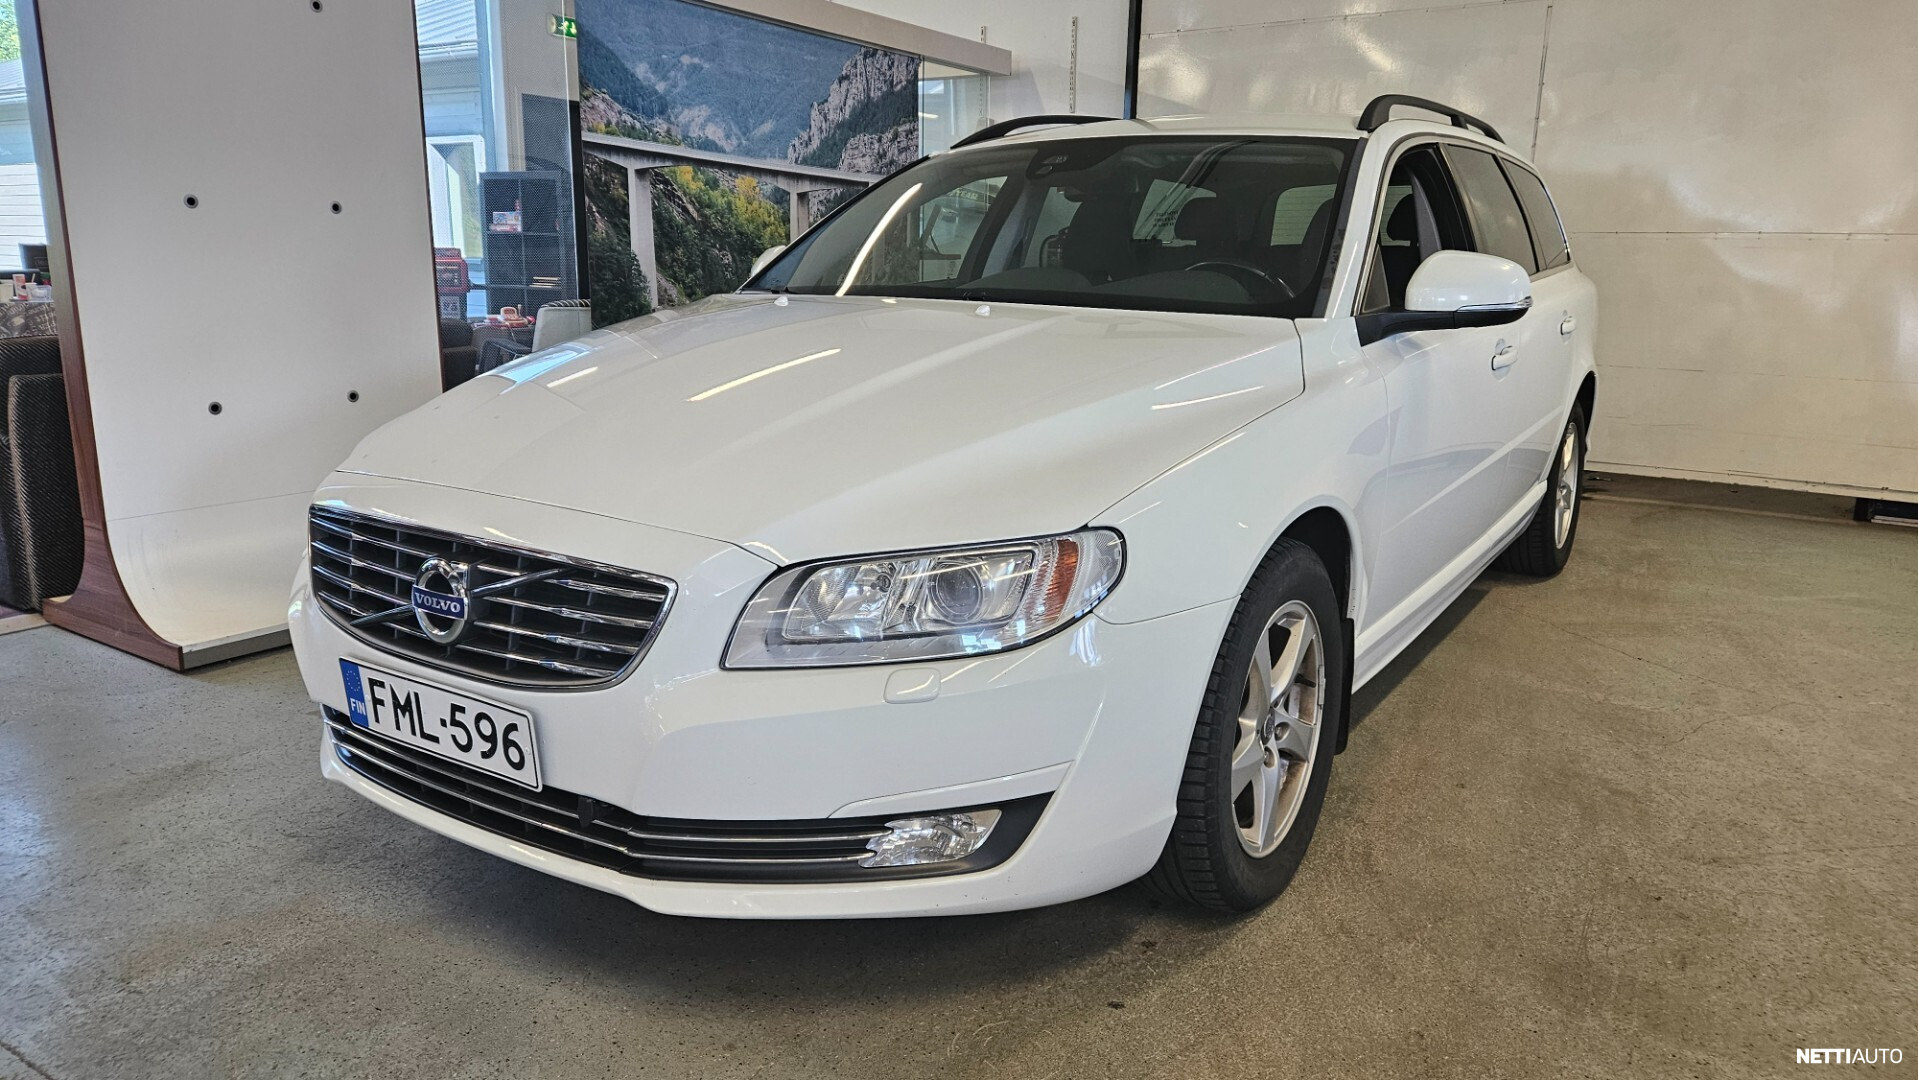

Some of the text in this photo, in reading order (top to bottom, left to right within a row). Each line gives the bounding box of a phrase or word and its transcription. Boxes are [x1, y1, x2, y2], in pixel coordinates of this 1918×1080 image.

[415, 592, 461, 613] VOLVO
[350, 697, 366, 716] FIN
[368, 677, 526, 771] FML-596
